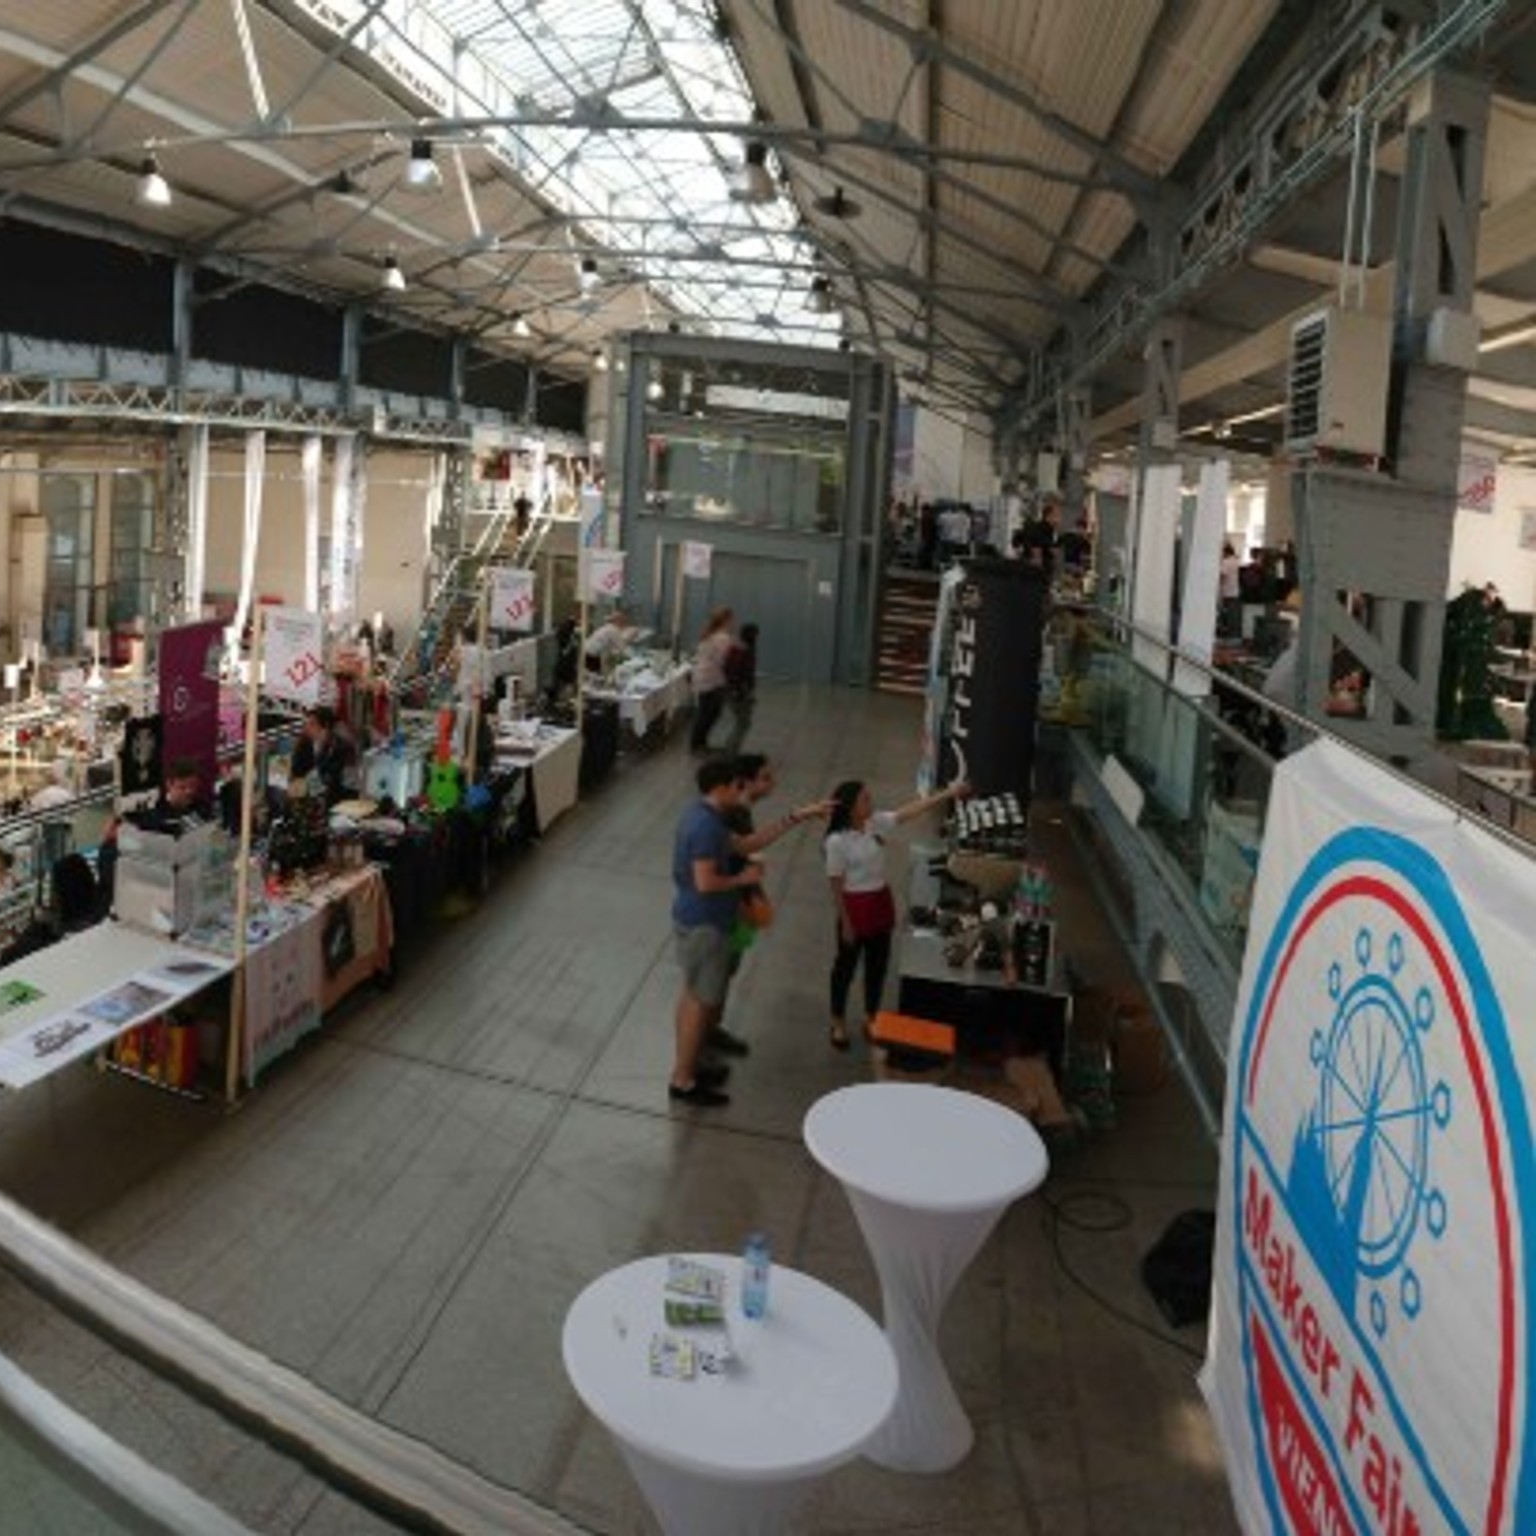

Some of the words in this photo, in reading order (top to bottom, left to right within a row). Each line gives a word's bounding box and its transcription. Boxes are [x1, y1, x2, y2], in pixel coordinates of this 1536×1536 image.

[284, 652, 326, 688] 121
[1246, 1166, 1340, 1397] Maker
[1275, 1404, 1347, 1536] VIEN
